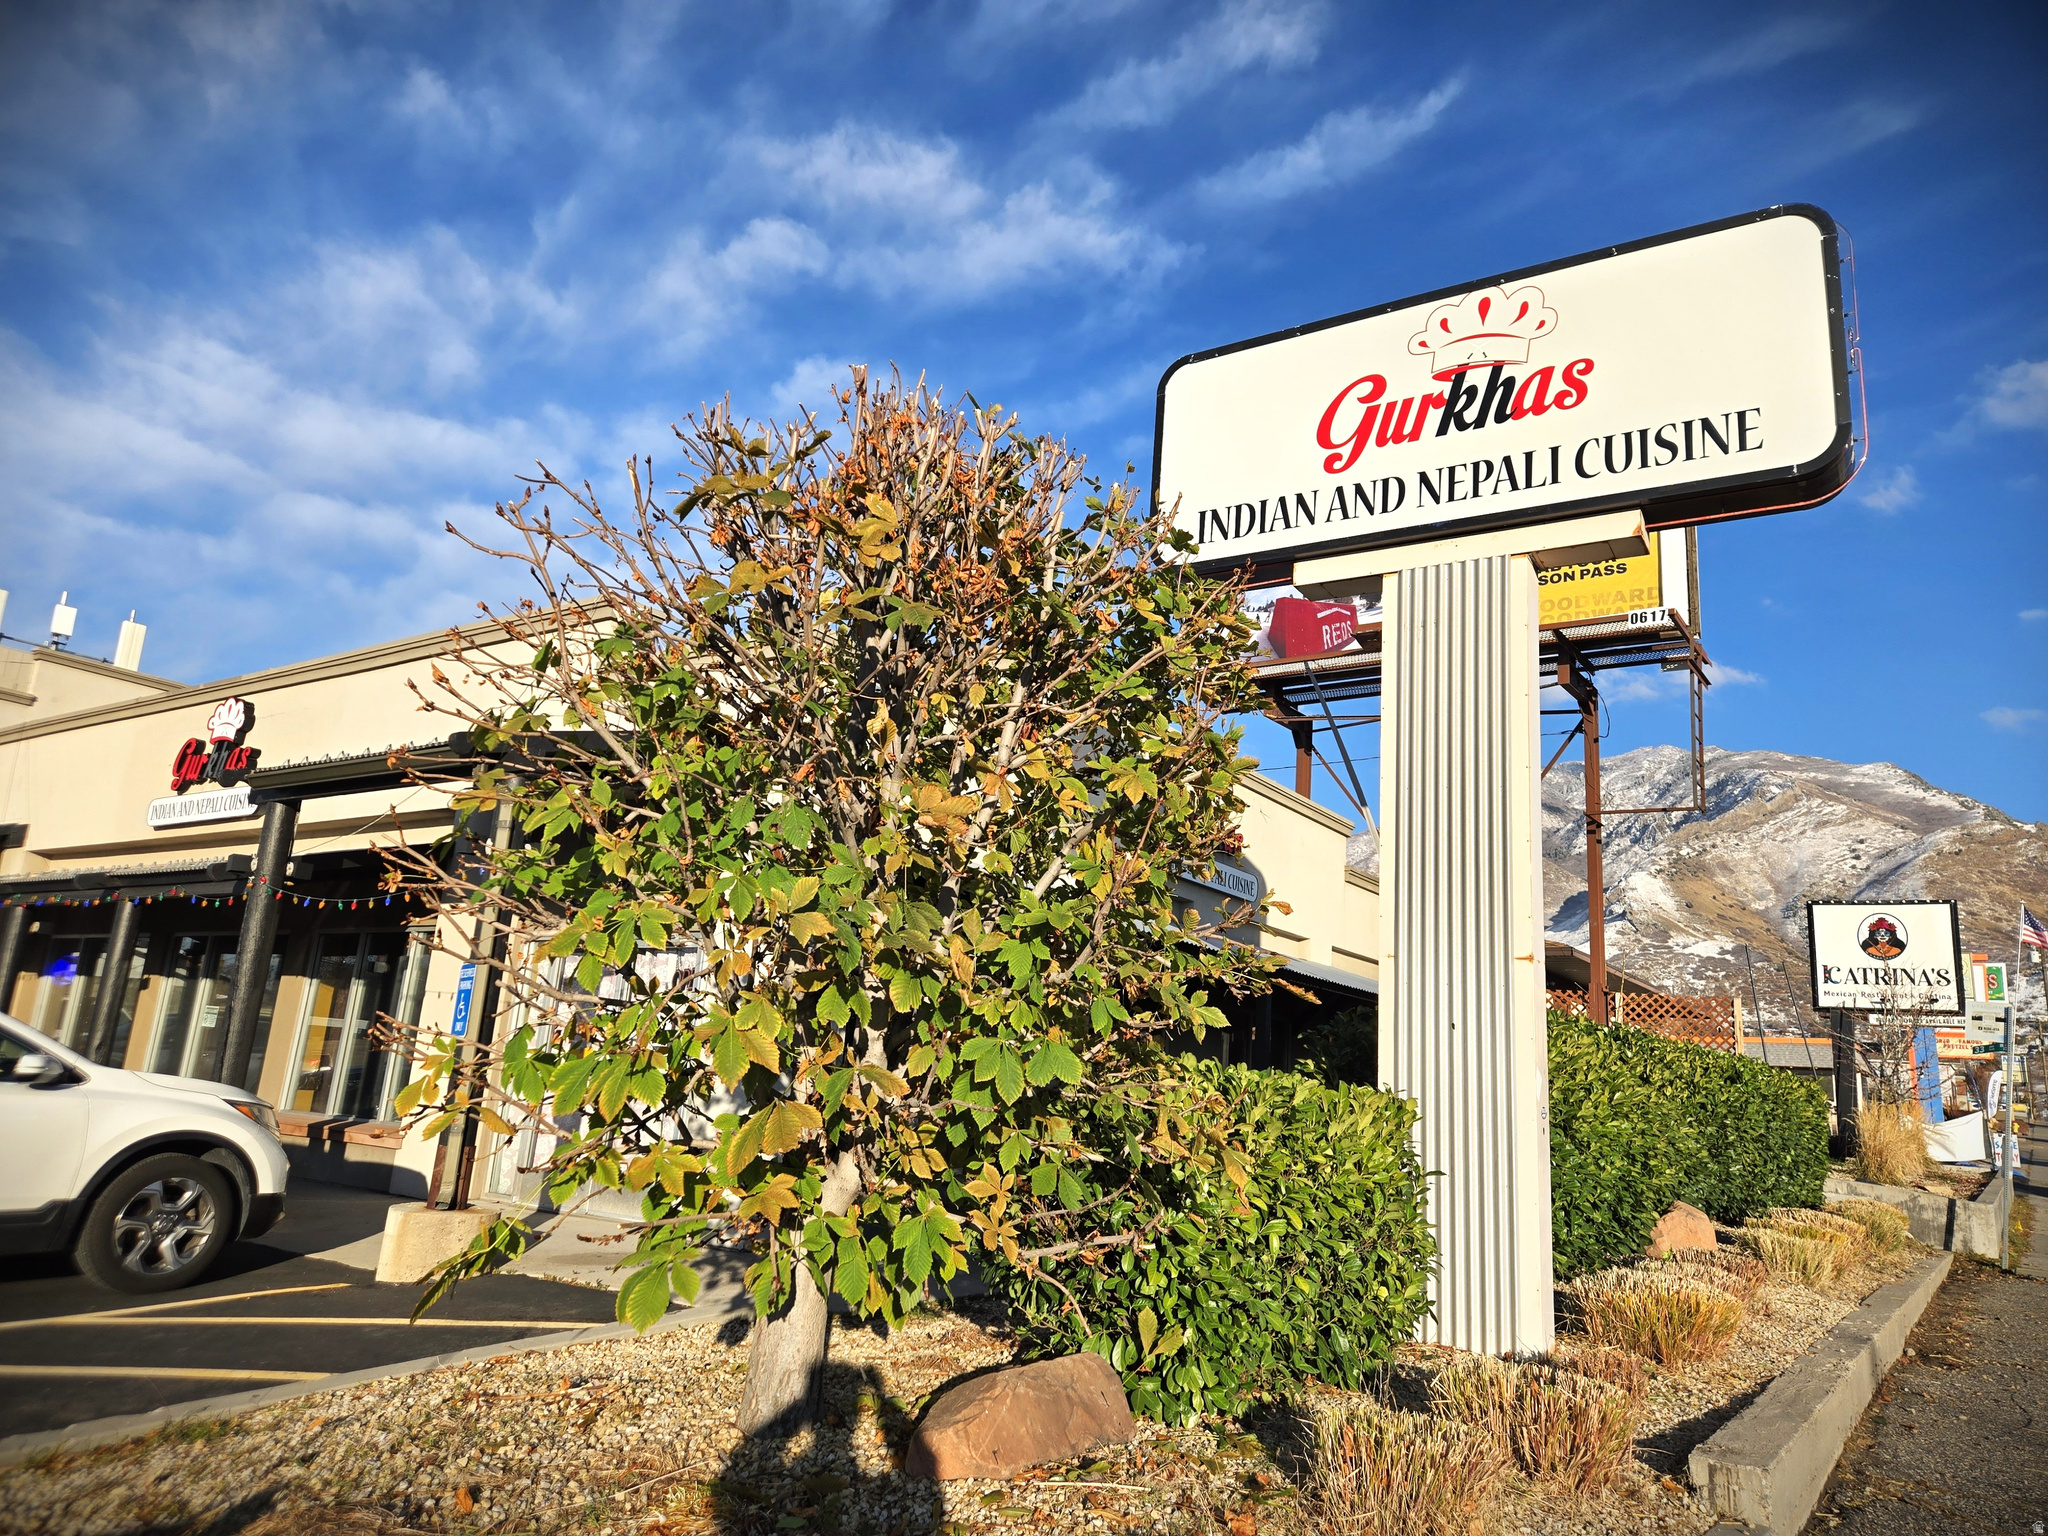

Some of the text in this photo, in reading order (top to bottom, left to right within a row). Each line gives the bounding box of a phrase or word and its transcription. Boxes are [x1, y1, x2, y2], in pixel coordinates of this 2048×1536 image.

[1316, 358, 1595, 474] Gurkhas
[1198, 407, 1764, 545] INDIAN AND NEPALI CUISINE
[1538, 570, 1575, 586] SON
[1580, 563, 1628, 580] PASS
[1540, 586, 1658, 613] OODWARD
[1630, 609, 1666, 625] 0617
[171, 737, 252, 791] Gurkhas
[150, 802, 176, 820] INDIAN
[176, 799, 195, 818] AND
[194, 796, 224, 816] NEPALI
[1228, 873, 1255, 897] CUISINE
[1824, 990, 1857, 998] Mexican
[1995, 1141, 2017, 1150] SE
